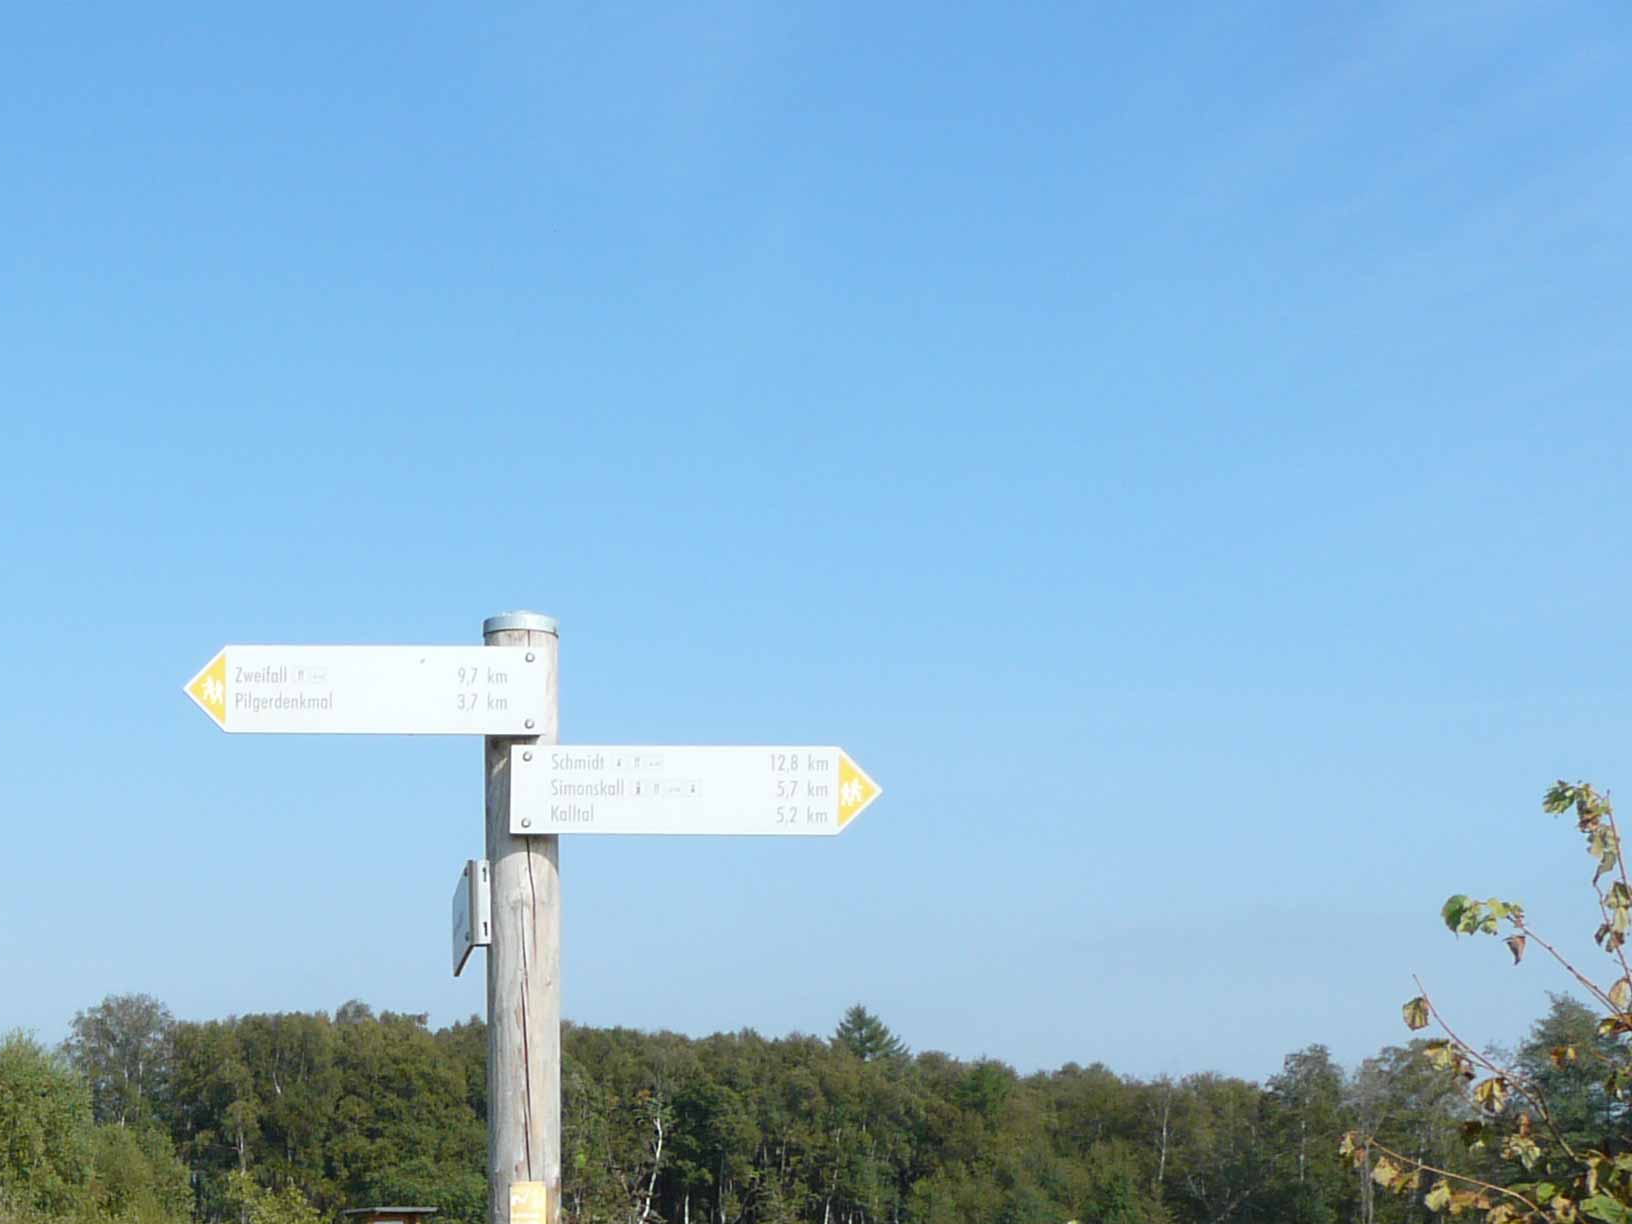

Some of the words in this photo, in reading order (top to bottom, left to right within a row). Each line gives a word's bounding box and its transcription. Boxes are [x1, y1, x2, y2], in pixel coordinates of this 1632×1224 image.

[235, 665, 288, 684] Zweifall
[458, 666, 478, 687] 9,7
[487, 666, 508, 684] km
[235, 691, 334, 712] Pilgerdenkmal
[457, 693, 478, 712] 3,7
[487, 692, 508, 711] km
[551, 753, 605, 771] Schmidt
[770, 753, 799, 773] 12,8
[807, 753, 829, 771] km
[550, 778, 624, 797] Simonskall
[777, 780, 798, 799] 5,7
[807, 780, 828, 798] km
[550, 804, 594, 823] Kalltal
[776, 806, 798, 827] 5,2
[806, 806, 828, 824] km
